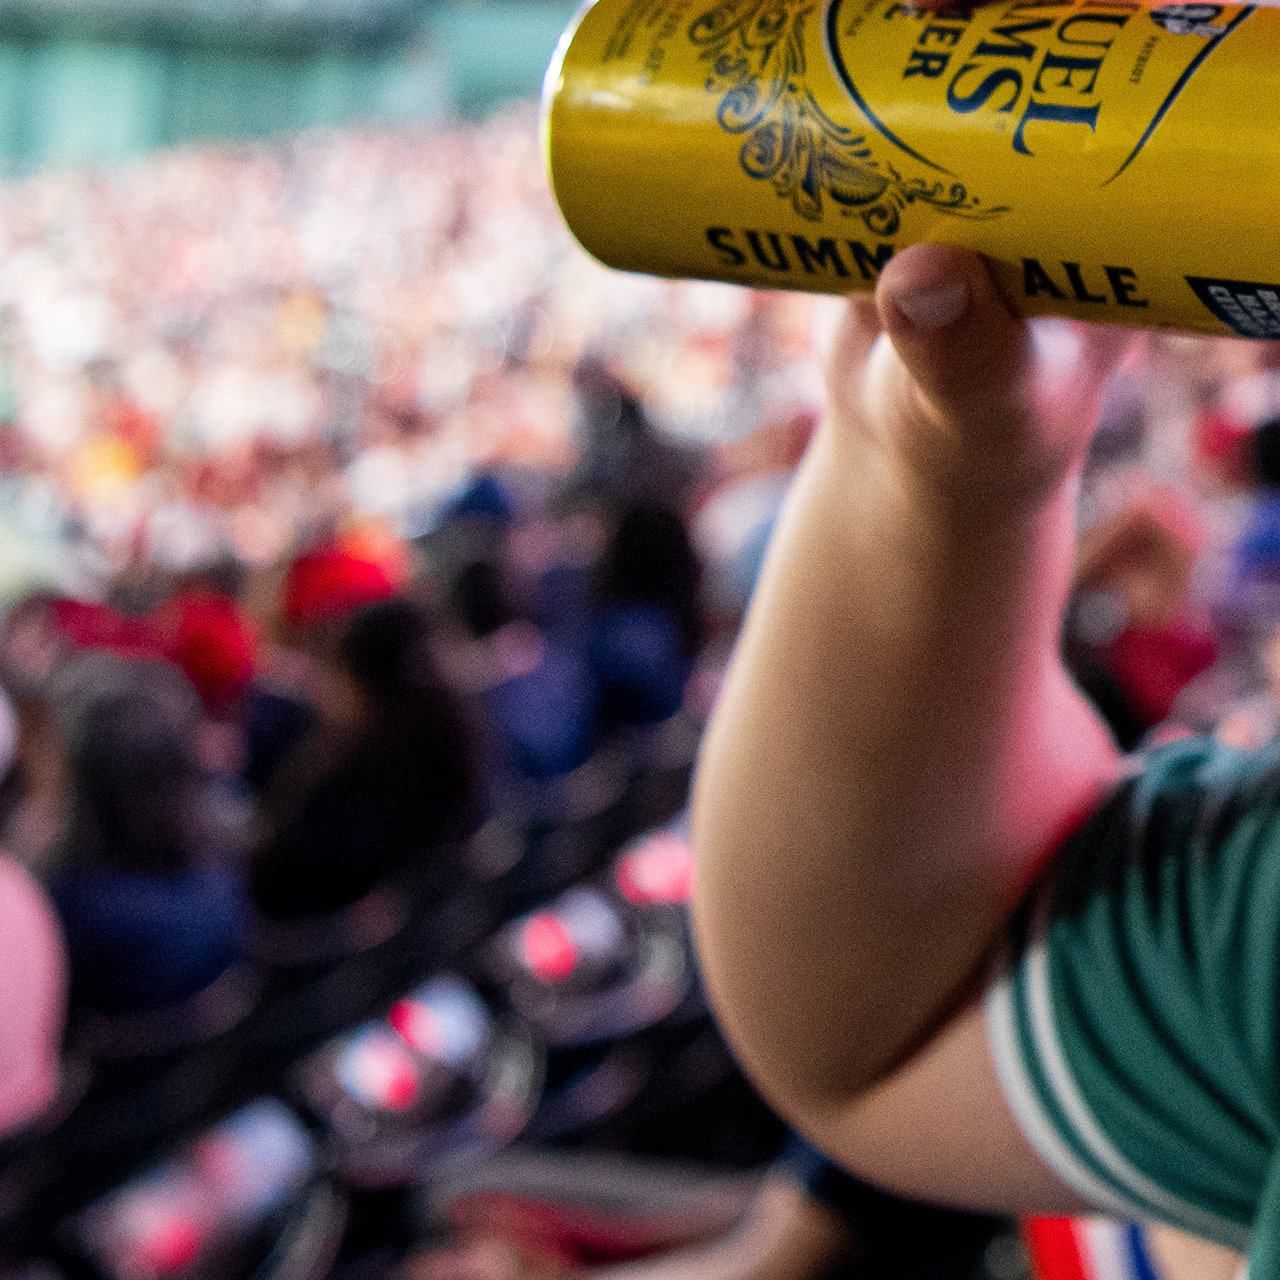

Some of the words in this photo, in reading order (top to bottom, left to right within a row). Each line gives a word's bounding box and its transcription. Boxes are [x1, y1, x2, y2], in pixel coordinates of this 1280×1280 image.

[1012, 4, 1136, 157] UEL
[706, 226, 896, 281] SUMM
[1020, 257, 1149, 309] ALE
